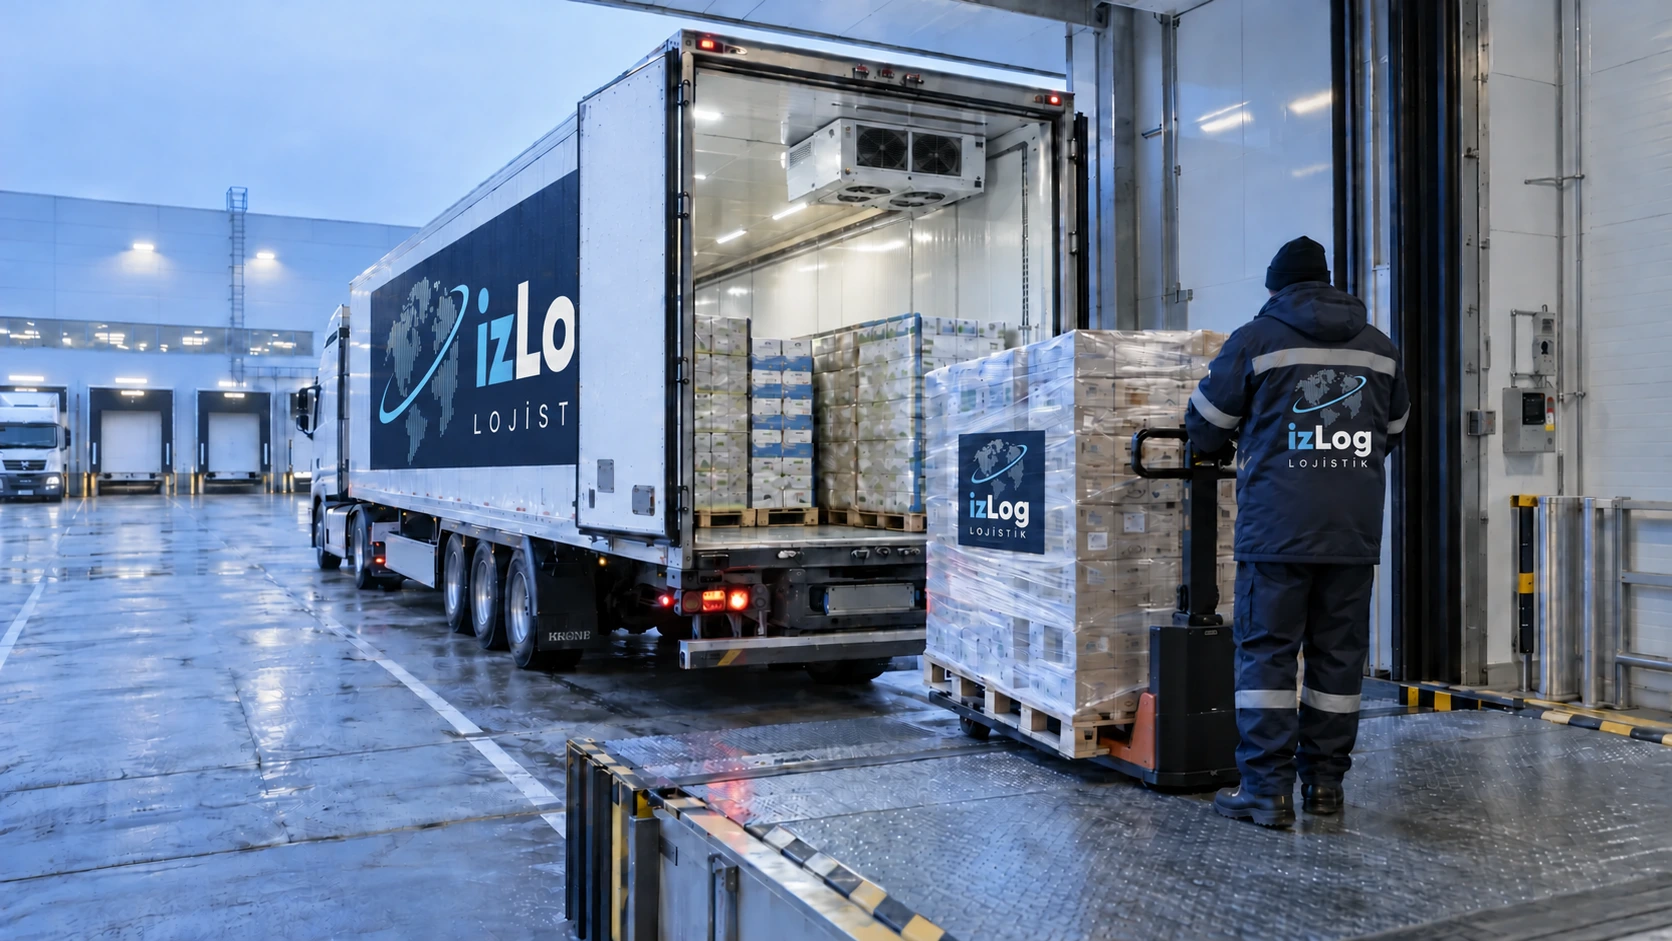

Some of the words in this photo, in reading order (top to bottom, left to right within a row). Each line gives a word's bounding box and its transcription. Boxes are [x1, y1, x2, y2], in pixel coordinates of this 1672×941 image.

[476, 280, 575, 388] izLo
[473, 401, 569, 435] LOJİST
[1288, 422, 1372, 458] izLog
[1288, 457, 1368, 468] LOJİSTİK
[969, 491, 1030, 528] izLog
[969, 527, 1026, 539] LOJİSTİK
